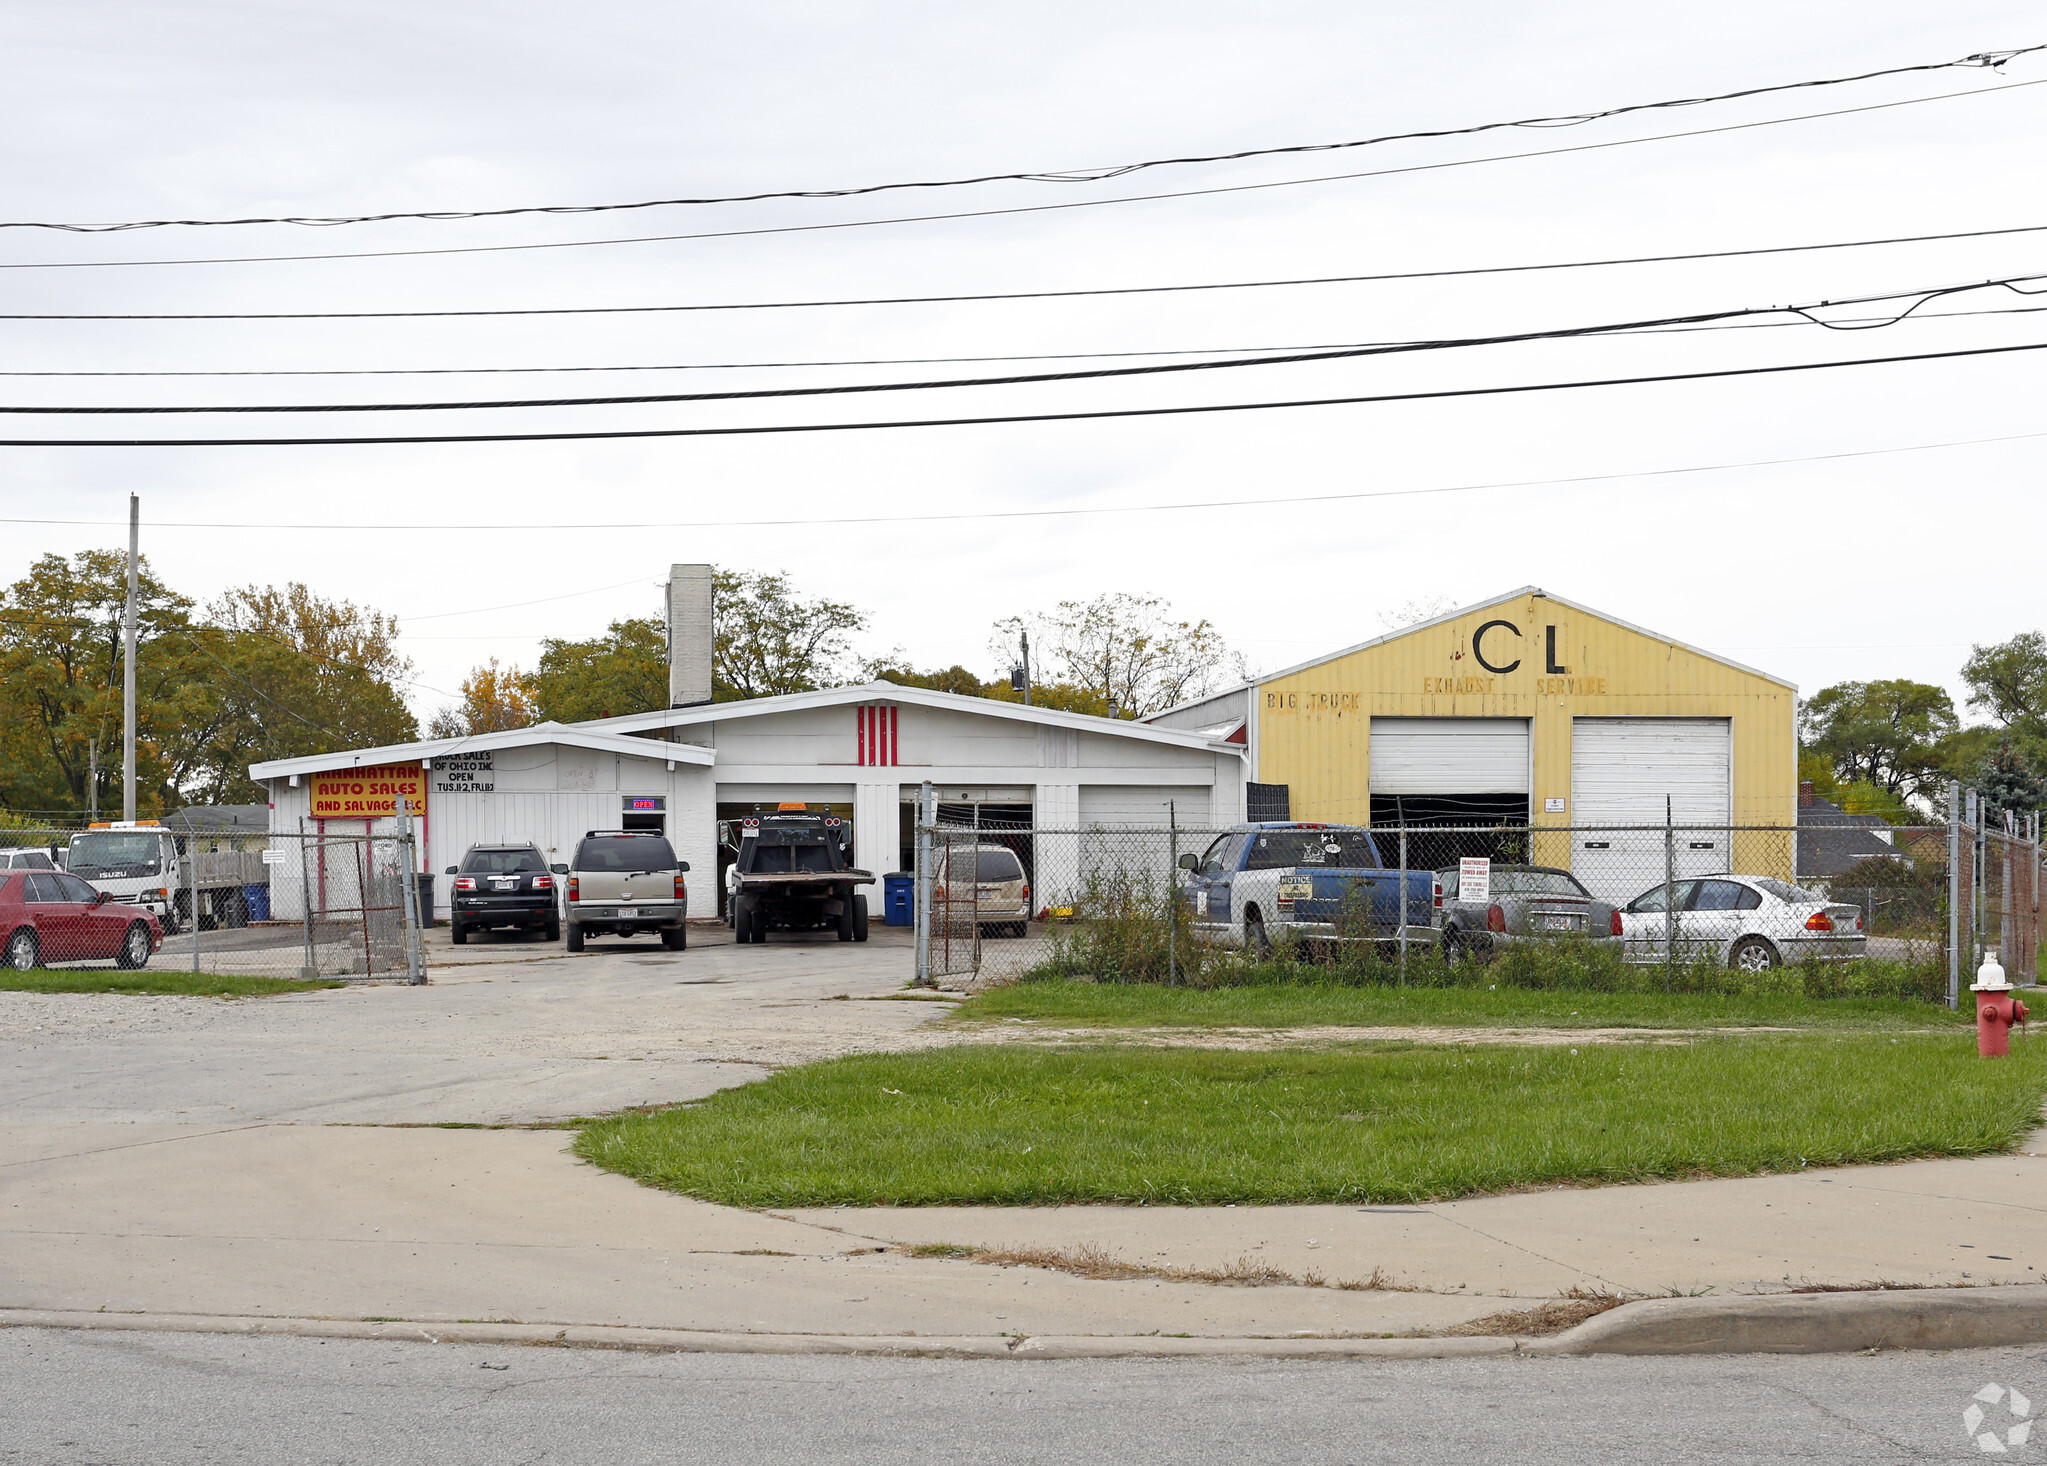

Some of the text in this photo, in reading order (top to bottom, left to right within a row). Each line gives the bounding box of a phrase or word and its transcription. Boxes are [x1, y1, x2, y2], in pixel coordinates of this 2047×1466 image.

[1472, 619, 1570, 674] C L
[1424, 676, 1606, 695] EXHAUST SERVICE
[1267, 692, 1360, 712] BIG TRUCK
[434, 762, 447, 771] OF
[449, 762, 477, 771] OHIO
[448, 772, 475, 781] OPEN
[318, 783, 417, 795] AUTO SALES
[316, 801, 341, 811] AND
[1281, 876, 1311, 884] NOTICE
